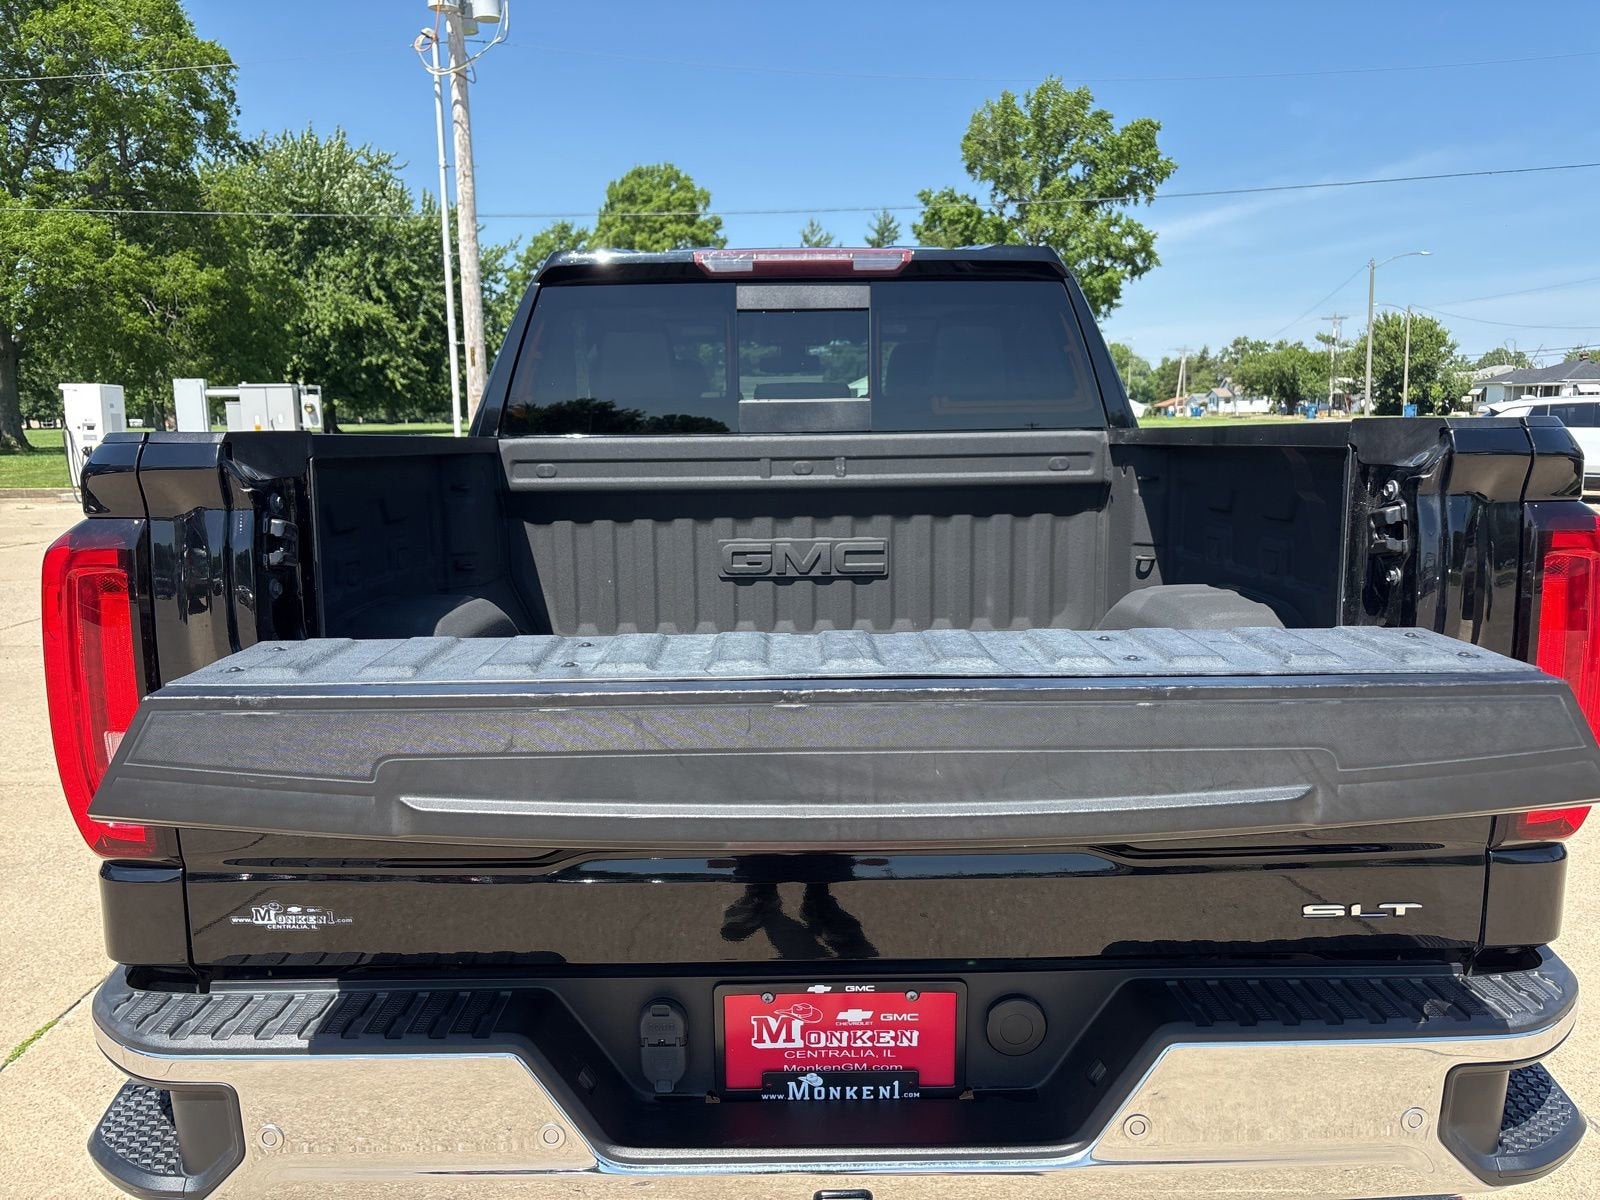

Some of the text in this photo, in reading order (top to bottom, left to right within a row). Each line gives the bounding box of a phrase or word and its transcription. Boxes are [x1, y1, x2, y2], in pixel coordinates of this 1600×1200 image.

[722, 541, 887, 575] GMC
[1302, 902, 1423, 918] SLT
[880, 1013, 919, 1021] GMC
[784, 1049, 896, 1059] CENTRALIA, IL
[783, 1062, 903, 1072] MonkenGM.com
